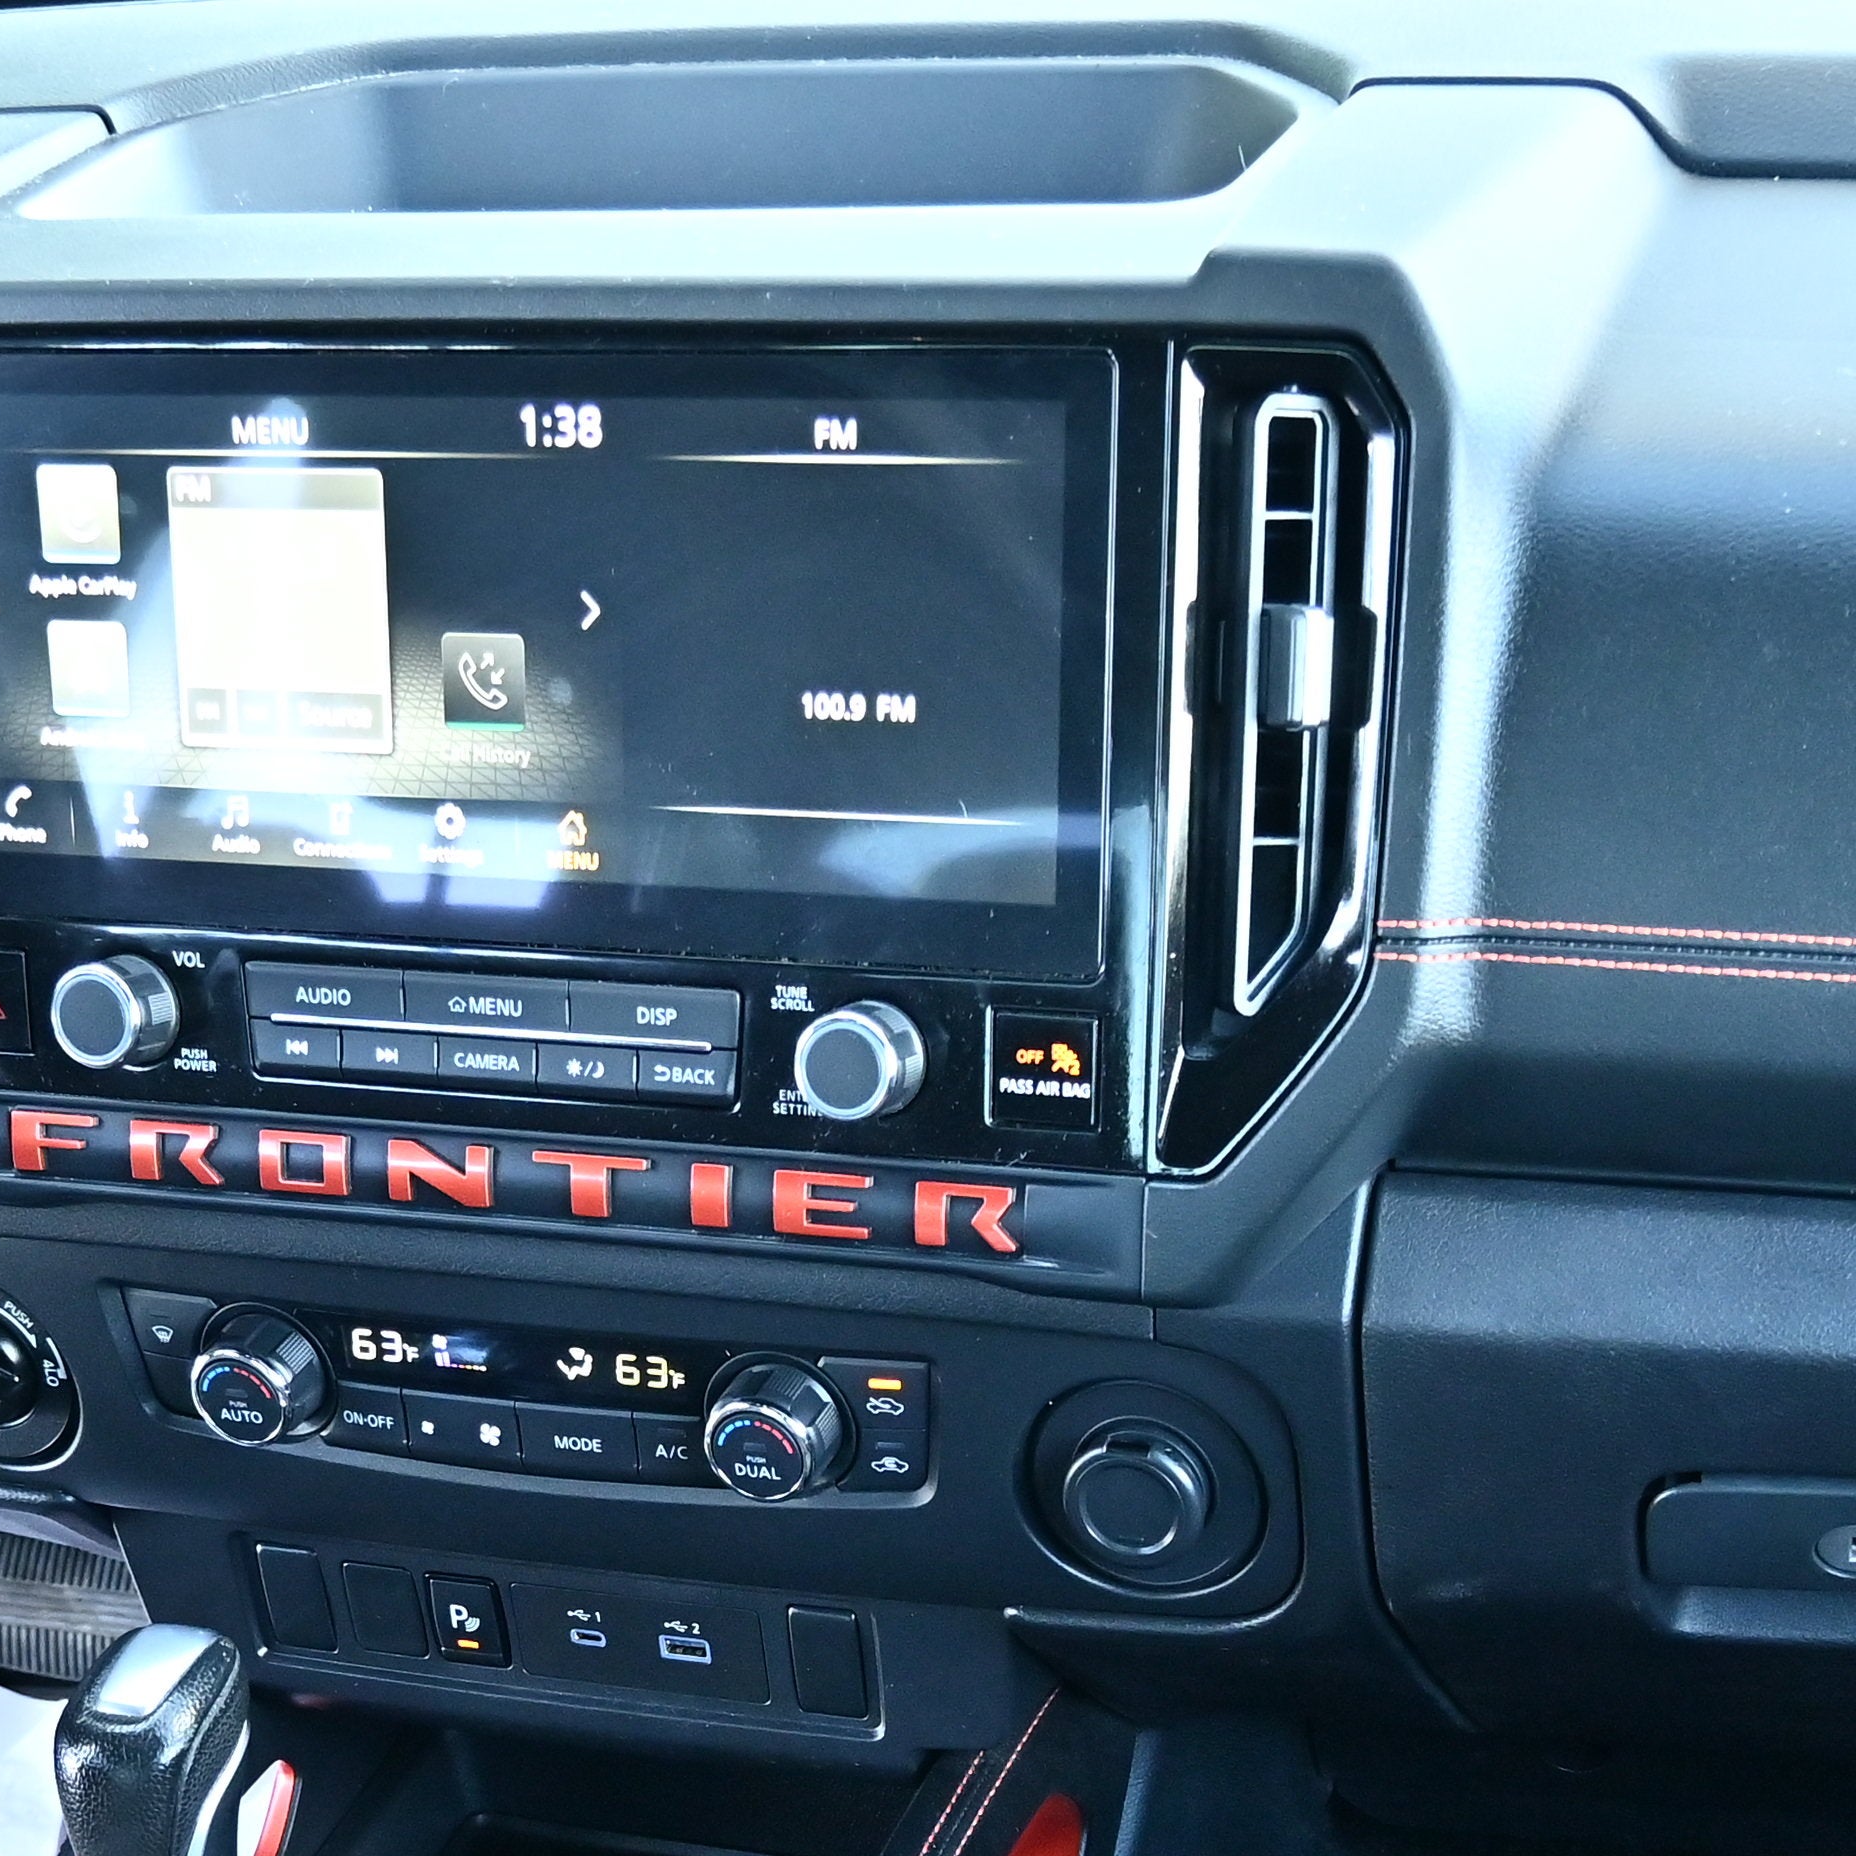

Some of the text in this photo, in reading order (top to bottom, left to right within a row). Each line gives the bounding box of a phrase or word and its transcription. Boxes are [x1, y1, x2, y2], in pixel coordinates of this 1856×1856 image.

[231, 415, 310, 446] MENU
[519, 403, 604, 450] 1:38
[813, 416, 858, 450] FM
[175, 475, 213, 504] FM
[800, 691, 917, 724] 100.9 FM
[472, 743, 532, 769] History
[115, 829, 149, 849] Info
[211, 834, 261, 855] Audio
[548, 851, 599, 871] MENU
[172, 950, 206, 970] VOL
[295, 985, 352, 1007] AUDIO
[775, 985, 808, 999] TUNE
[468, 996, 523, 1018] MENU
[770, 997, 815, 1012] SCROLL
[636, 1006, 678, 1027] DISP
[180, 1046, 208, 1060] PUSH
[454, 1052, 520, 1073] CAMERA
[1016, 1048, 1045, 1065] OFF
[173, 1058, 217, 1073] POWER
[671, 1067, 716, 1086] BACK
[999, 1077, 1091, 1099] PASS AIR BAG
[772, 1100, 824, 1117] SETTIN
[10, 1106, 1021, 1254] FRONTIER
[3, 1300, 35, 1330] PUSH
[42, 1358, 60, 1388] 4LO
[220, 1406, 264, 1426] AUTO
[554, 1434, 603, 1454] MODE
[654, 1443, 689, 1461] A/C
[734, 1462, 782, 1481] DUAL
[449, 1603, 469, 1630] P
[593, 1611, 602, 1624] 1
[690, 1620, 701, 1635] 2
